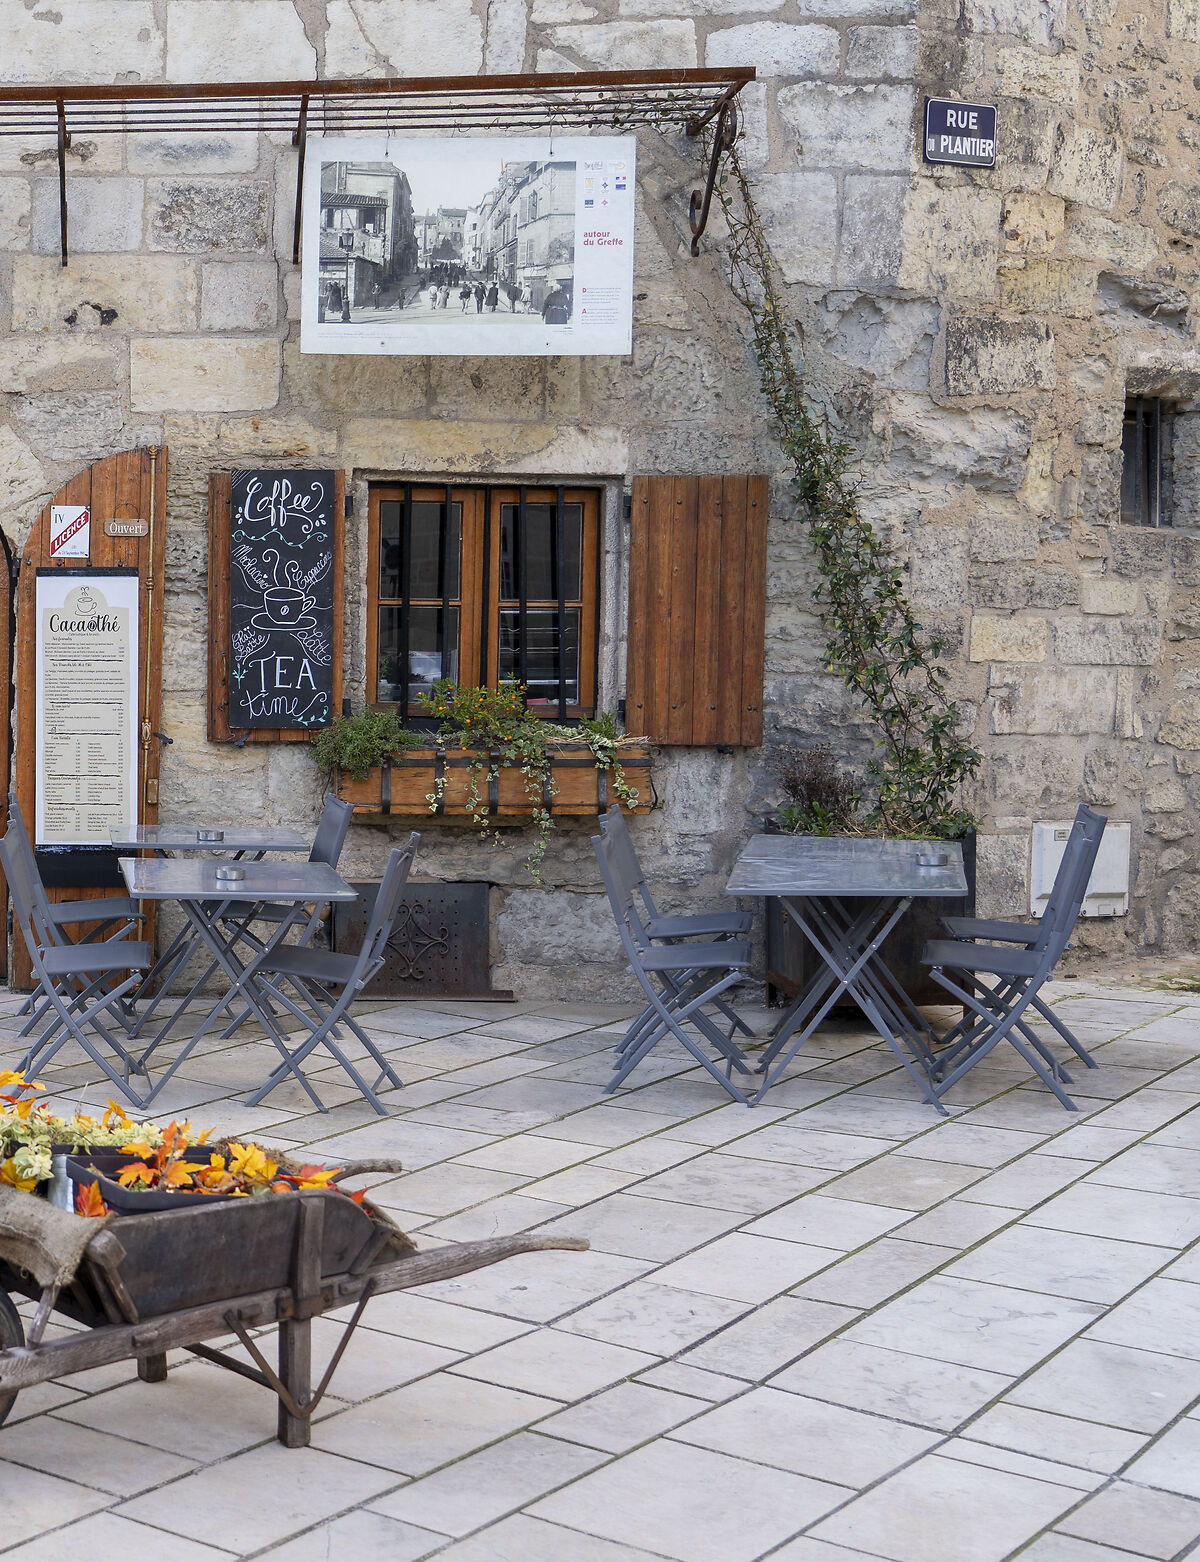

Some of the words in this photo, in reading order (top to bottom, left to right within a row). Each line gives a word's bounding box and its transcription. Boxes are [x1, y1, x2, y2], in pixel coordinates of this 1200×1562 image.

[946, 109, 978, 130] RUE
[940, 134, 994, 157] PLANTIER
[597, 238, 624, 246] Greffe
[243, 477, 324, 533] Coffee
[54, 514, 64, 524] IV
[54, 513, 86, 550] LICENCE
[109, 522, 144, 534] Ouvert
[50, 614, 120, 632] Cacaothé
[234, 634, 266, 662] Latte
[297, 627, 331, 666] Latte
[249, 650, 317, 693] TEA
[240, 690, 327, 720] time
